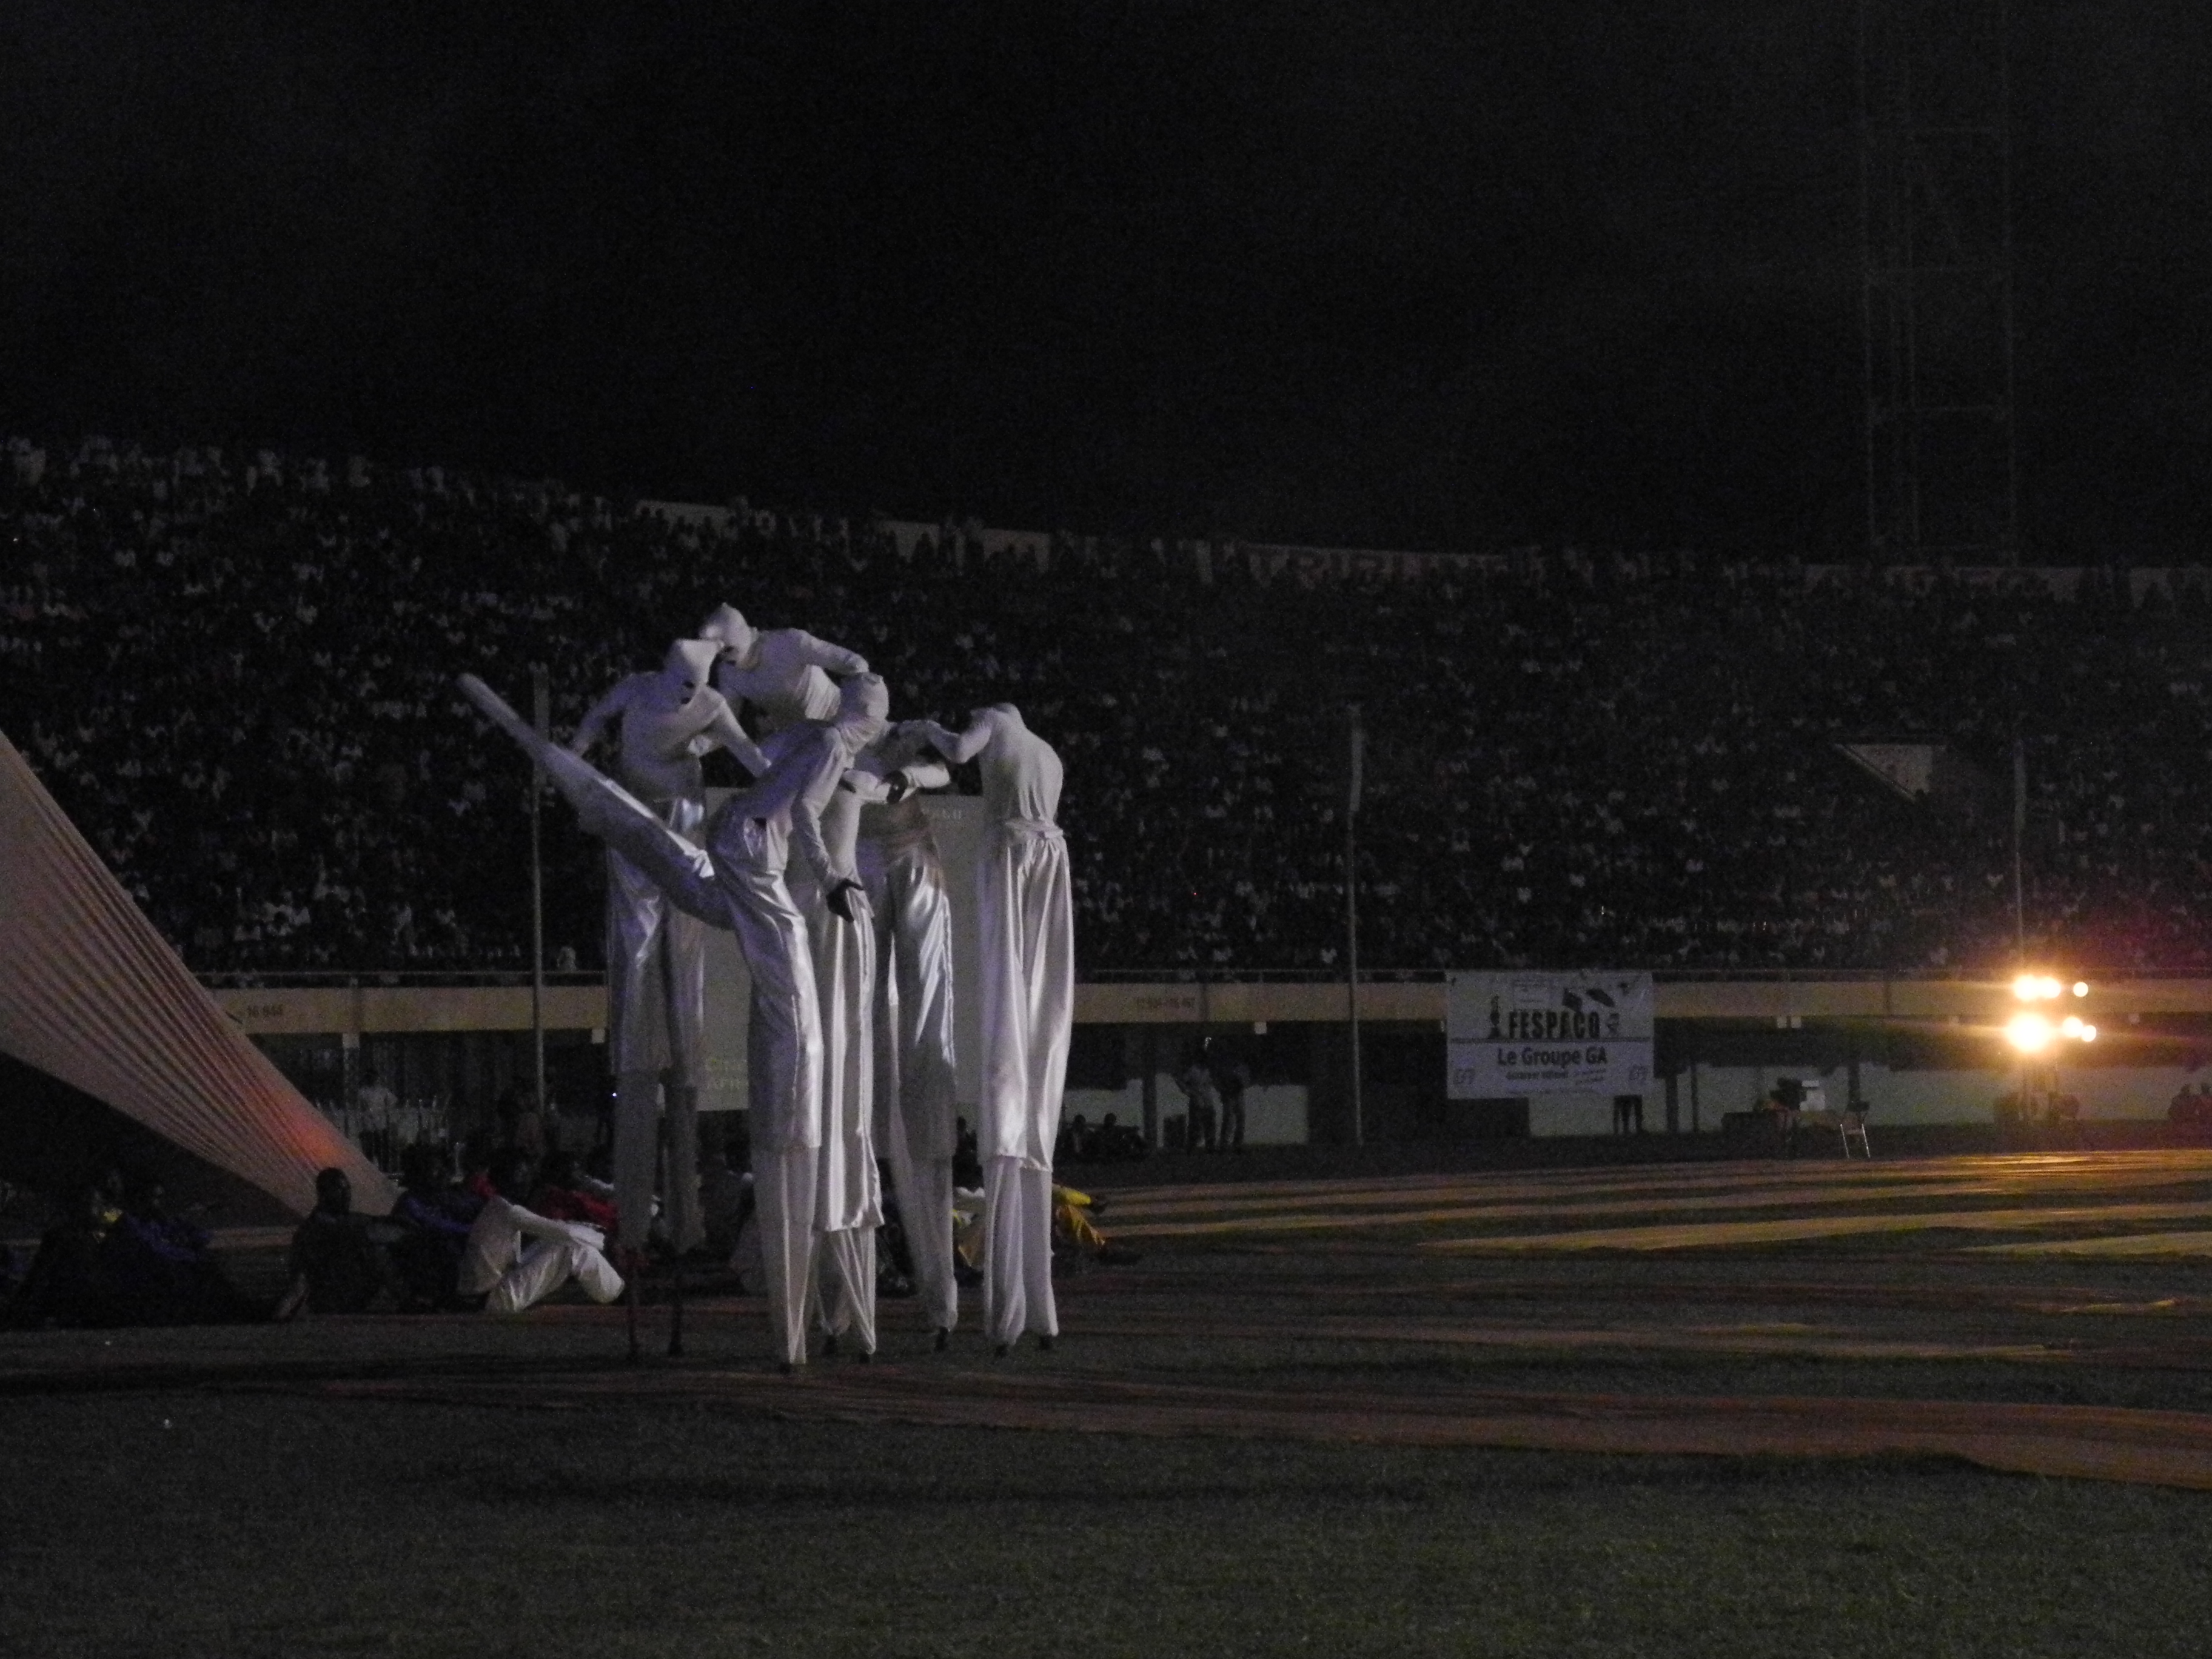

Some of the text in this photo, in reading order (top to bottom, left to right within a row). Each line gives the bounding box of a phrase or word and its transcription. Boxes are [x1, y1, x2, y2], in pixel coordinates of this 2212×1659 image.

[1509, 1011, 1600, 1039] FESPACO
[1498, 1046, 1607, 1068] Le Groupe GA
